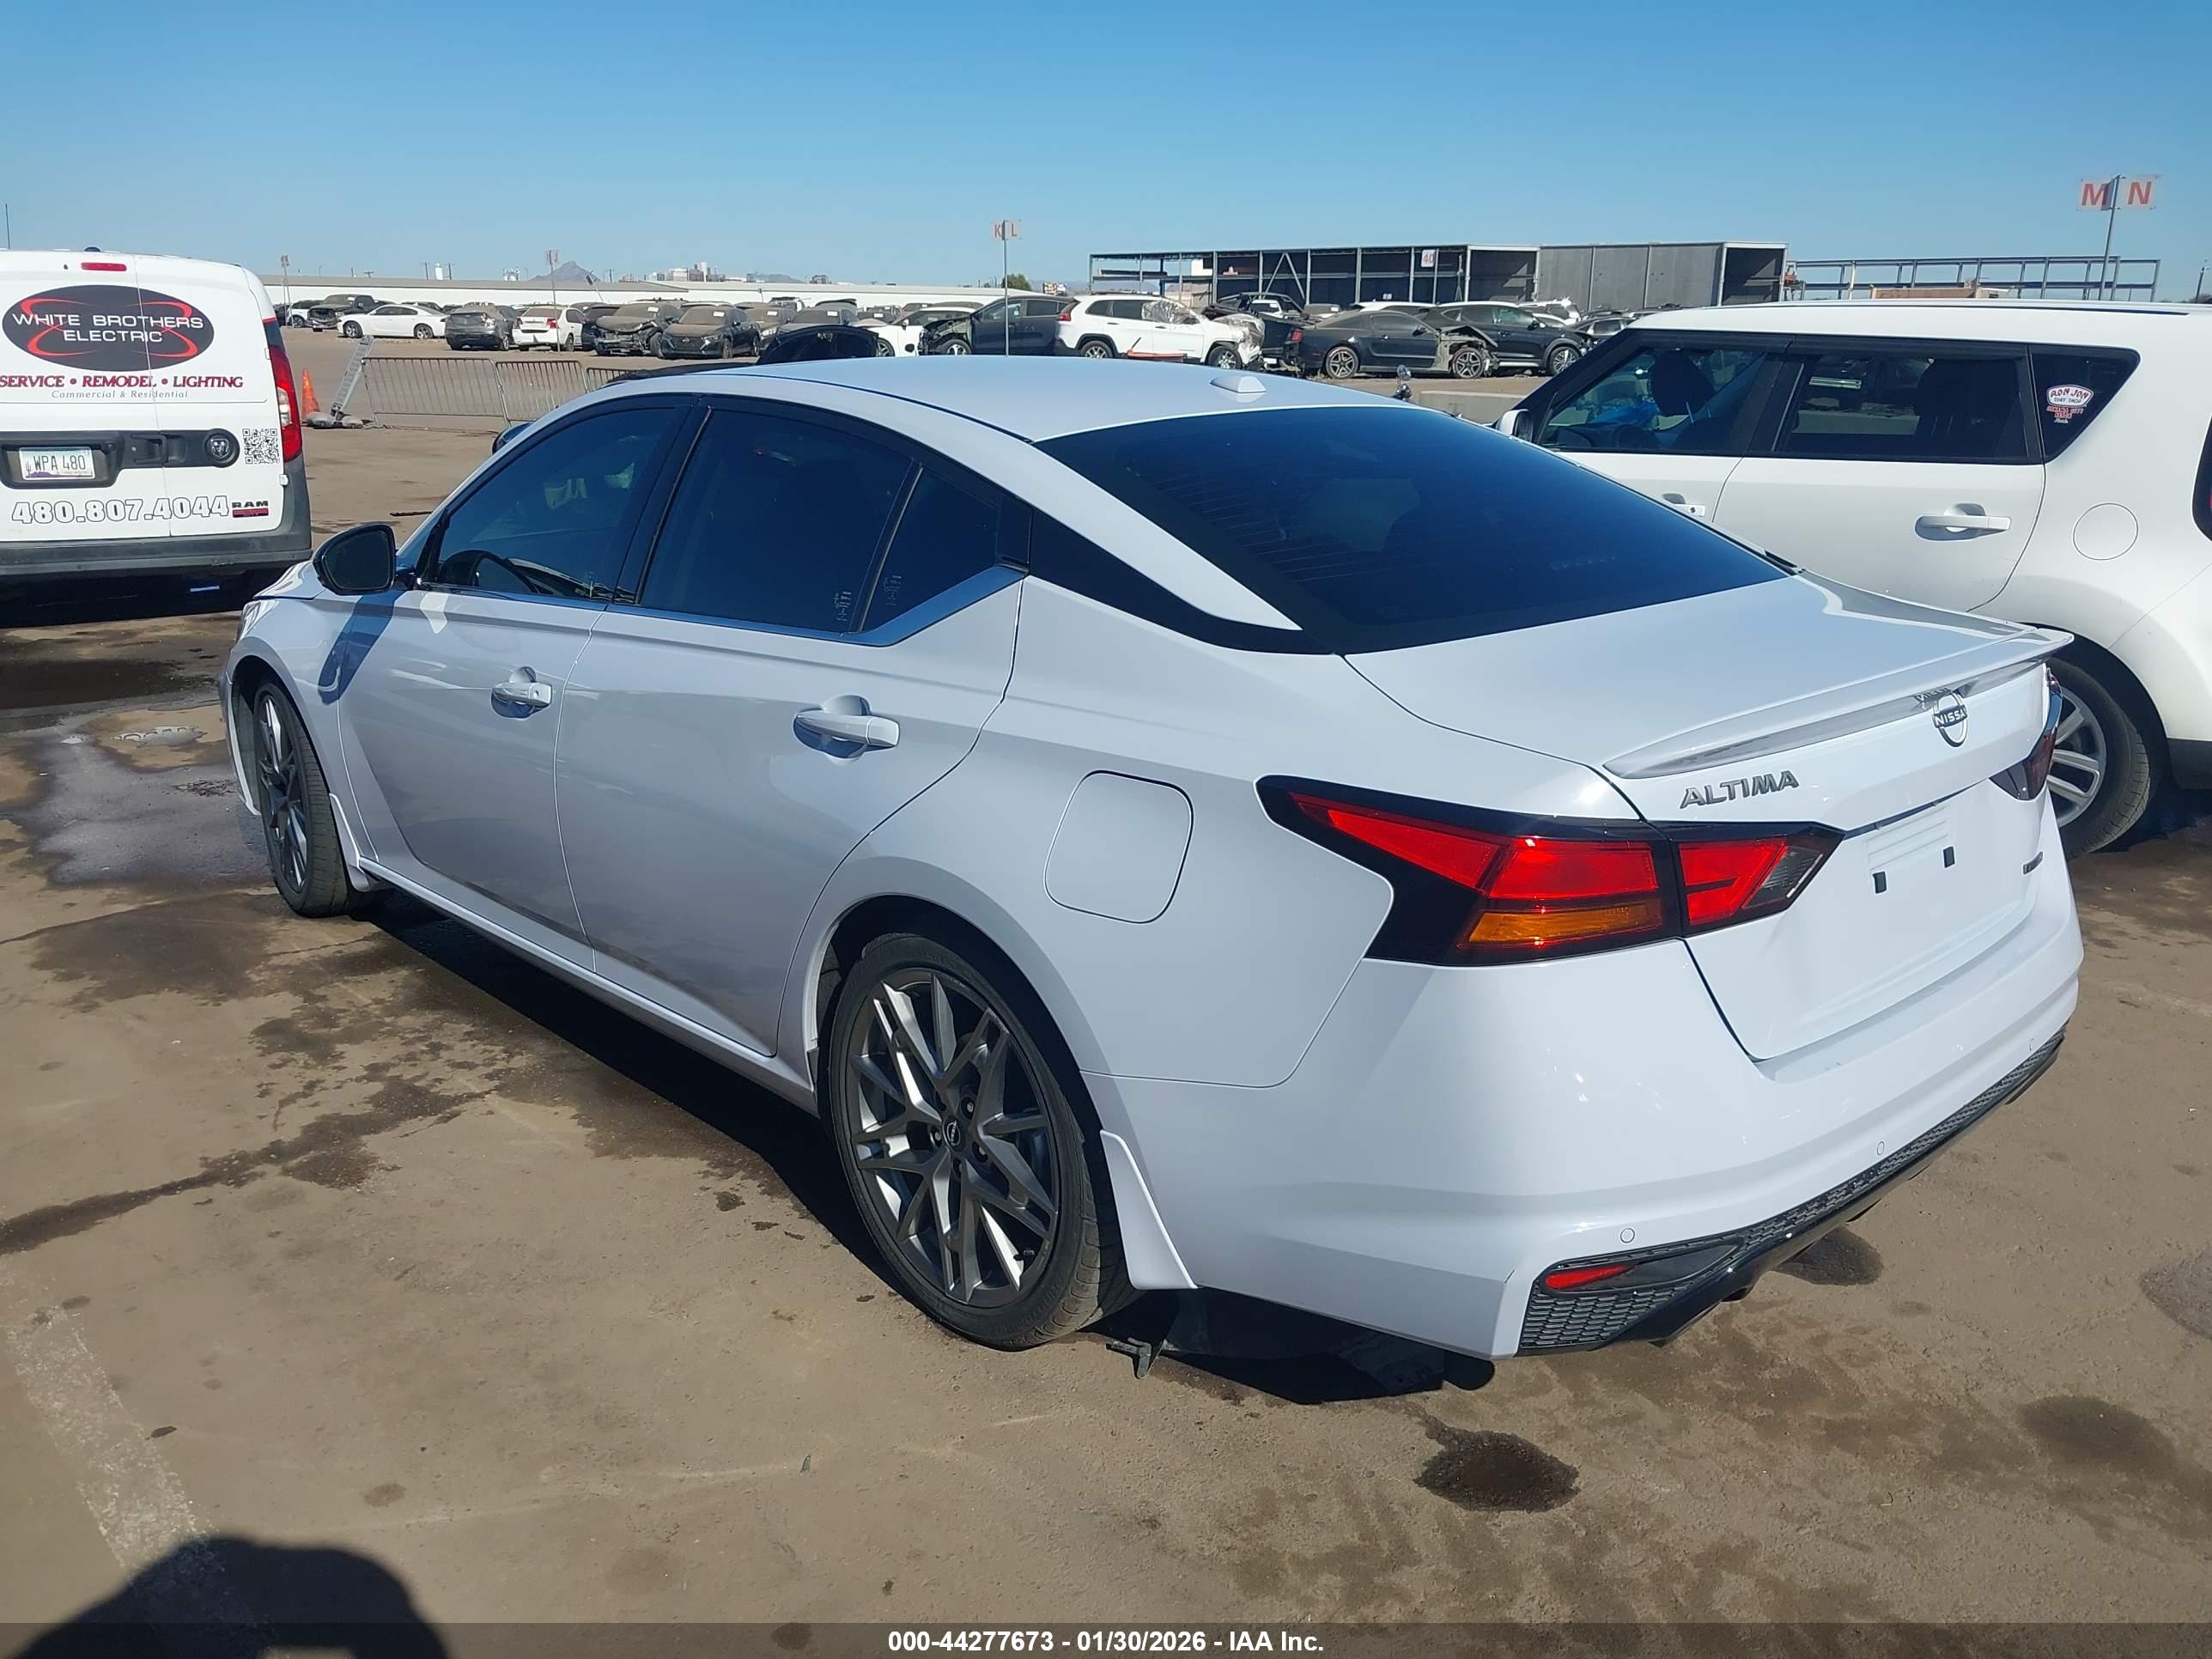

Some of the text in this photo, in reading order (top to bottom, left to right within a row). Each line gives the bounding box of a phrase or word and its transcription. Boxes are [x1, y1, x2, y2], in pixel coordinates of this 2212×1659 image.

[2081, 183, 2109, 206] M
[2128, 181, 2152, 205] N
[994, 224, 1001, 238] K
[1011, 223, 1018, 237] L
[12, 313, 204, 328] WHITE BROTHERS
[64, 330, 162, 342] ELECTRIC
[0, 375, 243, 387] SERVICE REMODEL LIGHTING
[52, 390, 115, 398] Commercial
[131, 390, 188, 398] Residential
[2051, 388, 2089, 400] RON JON
[33, 455, 85, 471] WPA 480
[11, 495, 229, 524] 480.807.4044
[1680, 770, 1800, 809] ALTIMA
